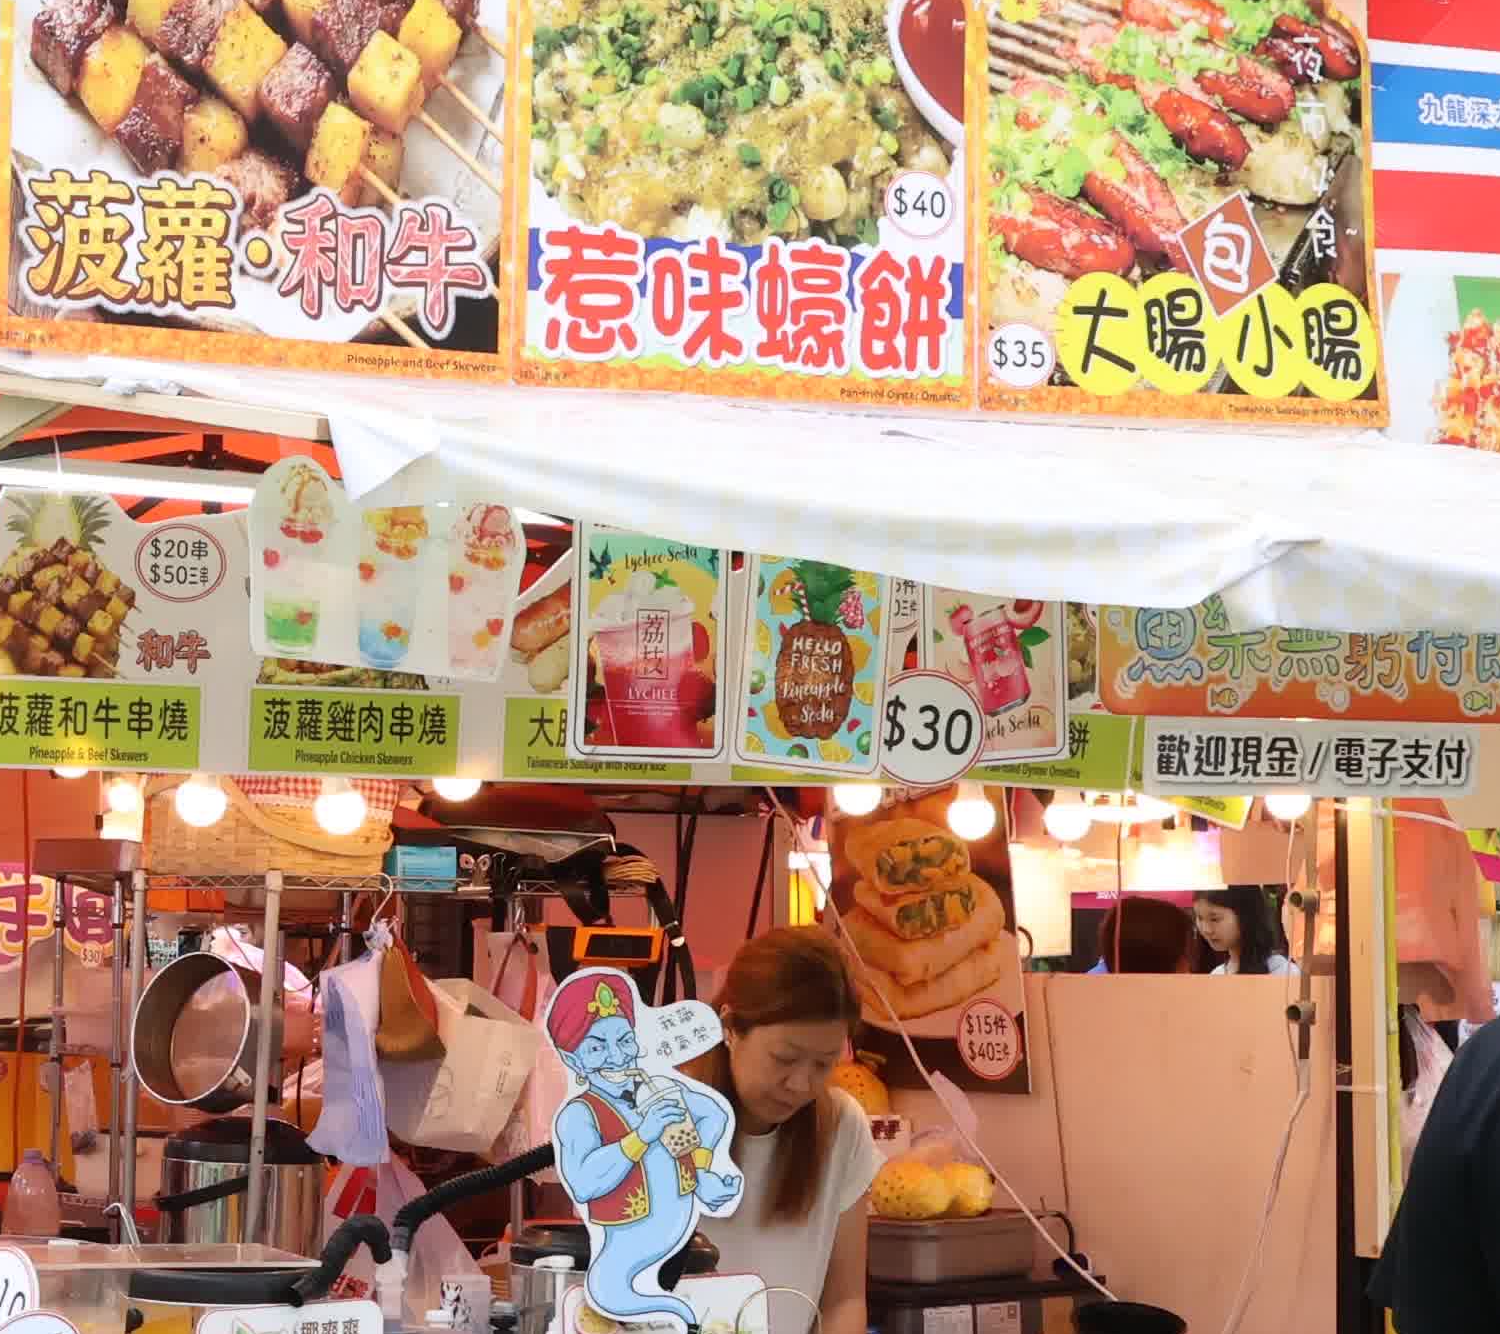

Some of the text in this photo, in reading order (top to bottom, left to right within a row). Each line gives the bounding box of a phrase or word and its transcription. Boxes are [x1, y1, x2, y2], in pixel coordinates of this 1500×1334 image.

[891, 185, 948, 221] $40
[543, 225, 954, 377] 惹味蠔餅
[347, 354, 497, 373] Pineapple and Beef Skewers
[991, 333, 1047, 374] $35
[149, 536, 210, 561] $20串
[624, 545, 698, 571] Lychee Soda
[136, 626, 213, 675] 和牛
[640, 613, 665, 676] 荔枝
[792, 635, 842, 654] HELLO
[791, 653, 843, 673] FRESH
[628, 686, 678, 700] LYCHEE
[782, 680, 846, 699] Pineapple
[263, 698, 448, 747] 菠蘿雞肉串燒
[799, 704, 836, 724] Soda
[1009, 713, 1041, 734] Soda
[883, 697, 974, 757] $30
[29, 745, 76, 761] Pineapple
[88, 747, 109, 759] Beef
[111, 747, 149, 762] Skewers
[295, 748, 413, 766] Pineapple Chicken Skewers
[1156, 734, 1300, 780] 歡迎現金
[1333, 737, 1472, 784] 電子支付
[80, 946, 102, 966] $30
